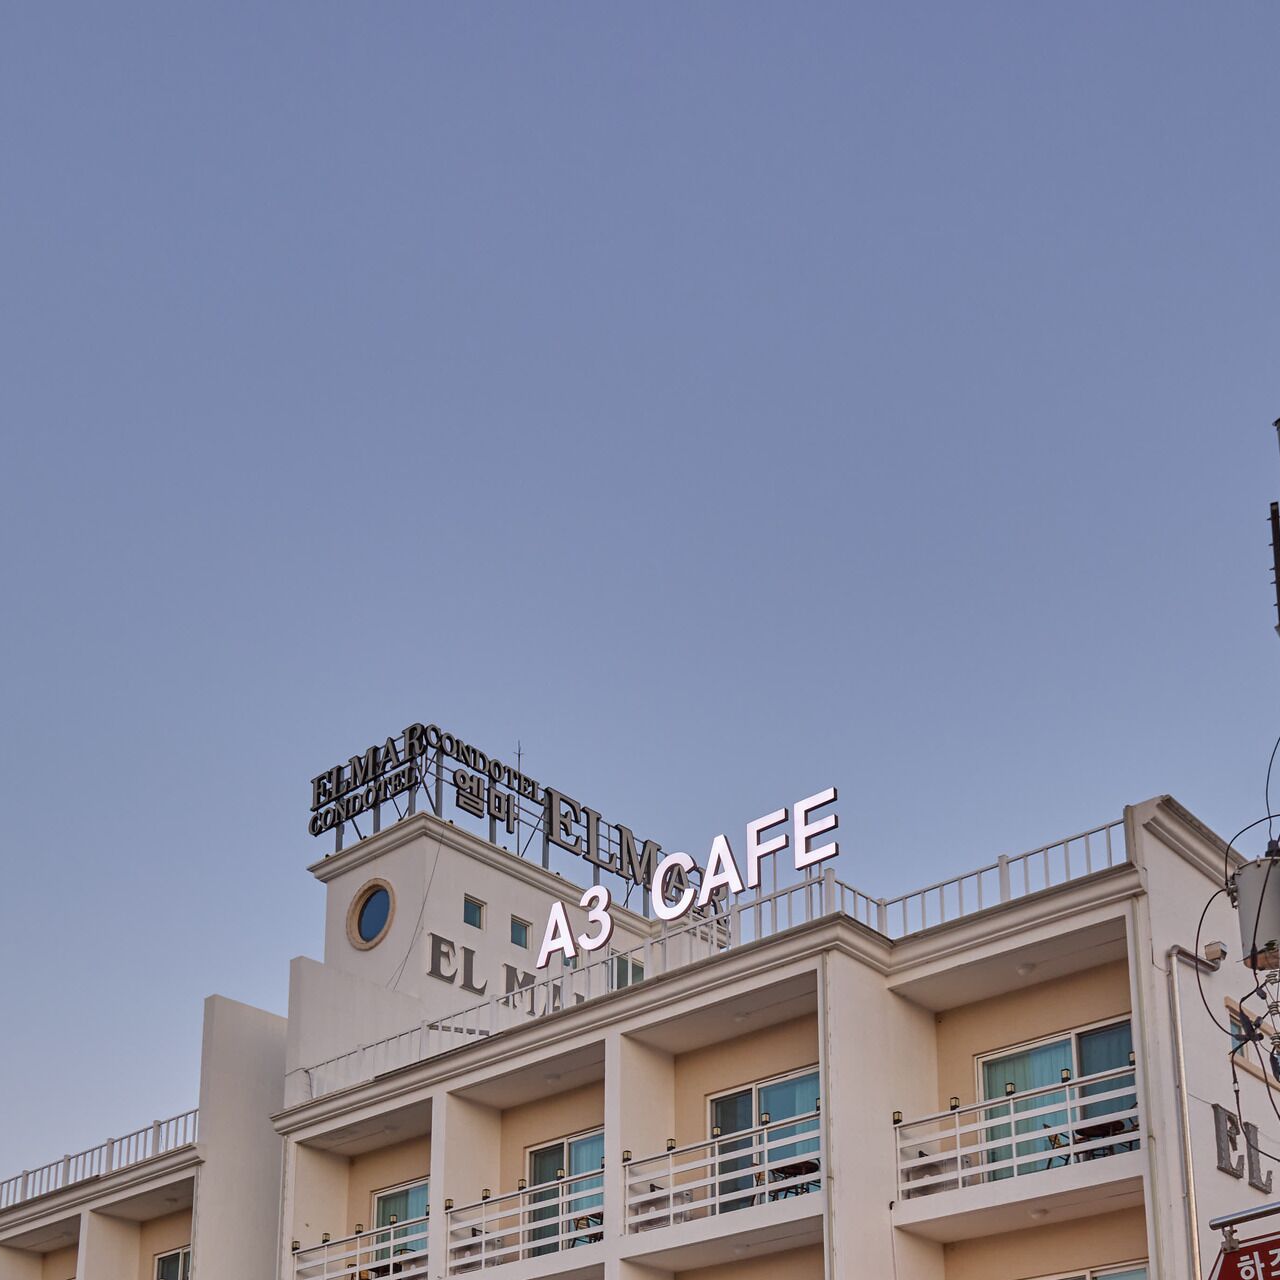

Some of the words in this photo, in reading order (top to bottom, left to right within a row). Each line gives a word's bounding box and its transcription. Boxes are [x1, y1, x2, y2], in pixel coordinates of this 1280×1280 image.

[308, 766, 421, 838] CONDOTEL
[310, 722, 426, 812] ELMAR
[425, 723, 546, 806] CONDOTEL
[453, 768, 519, 834] 엘마
[535, 885, 615, 970] A3
[651, 786, 839, 921] CAFE
